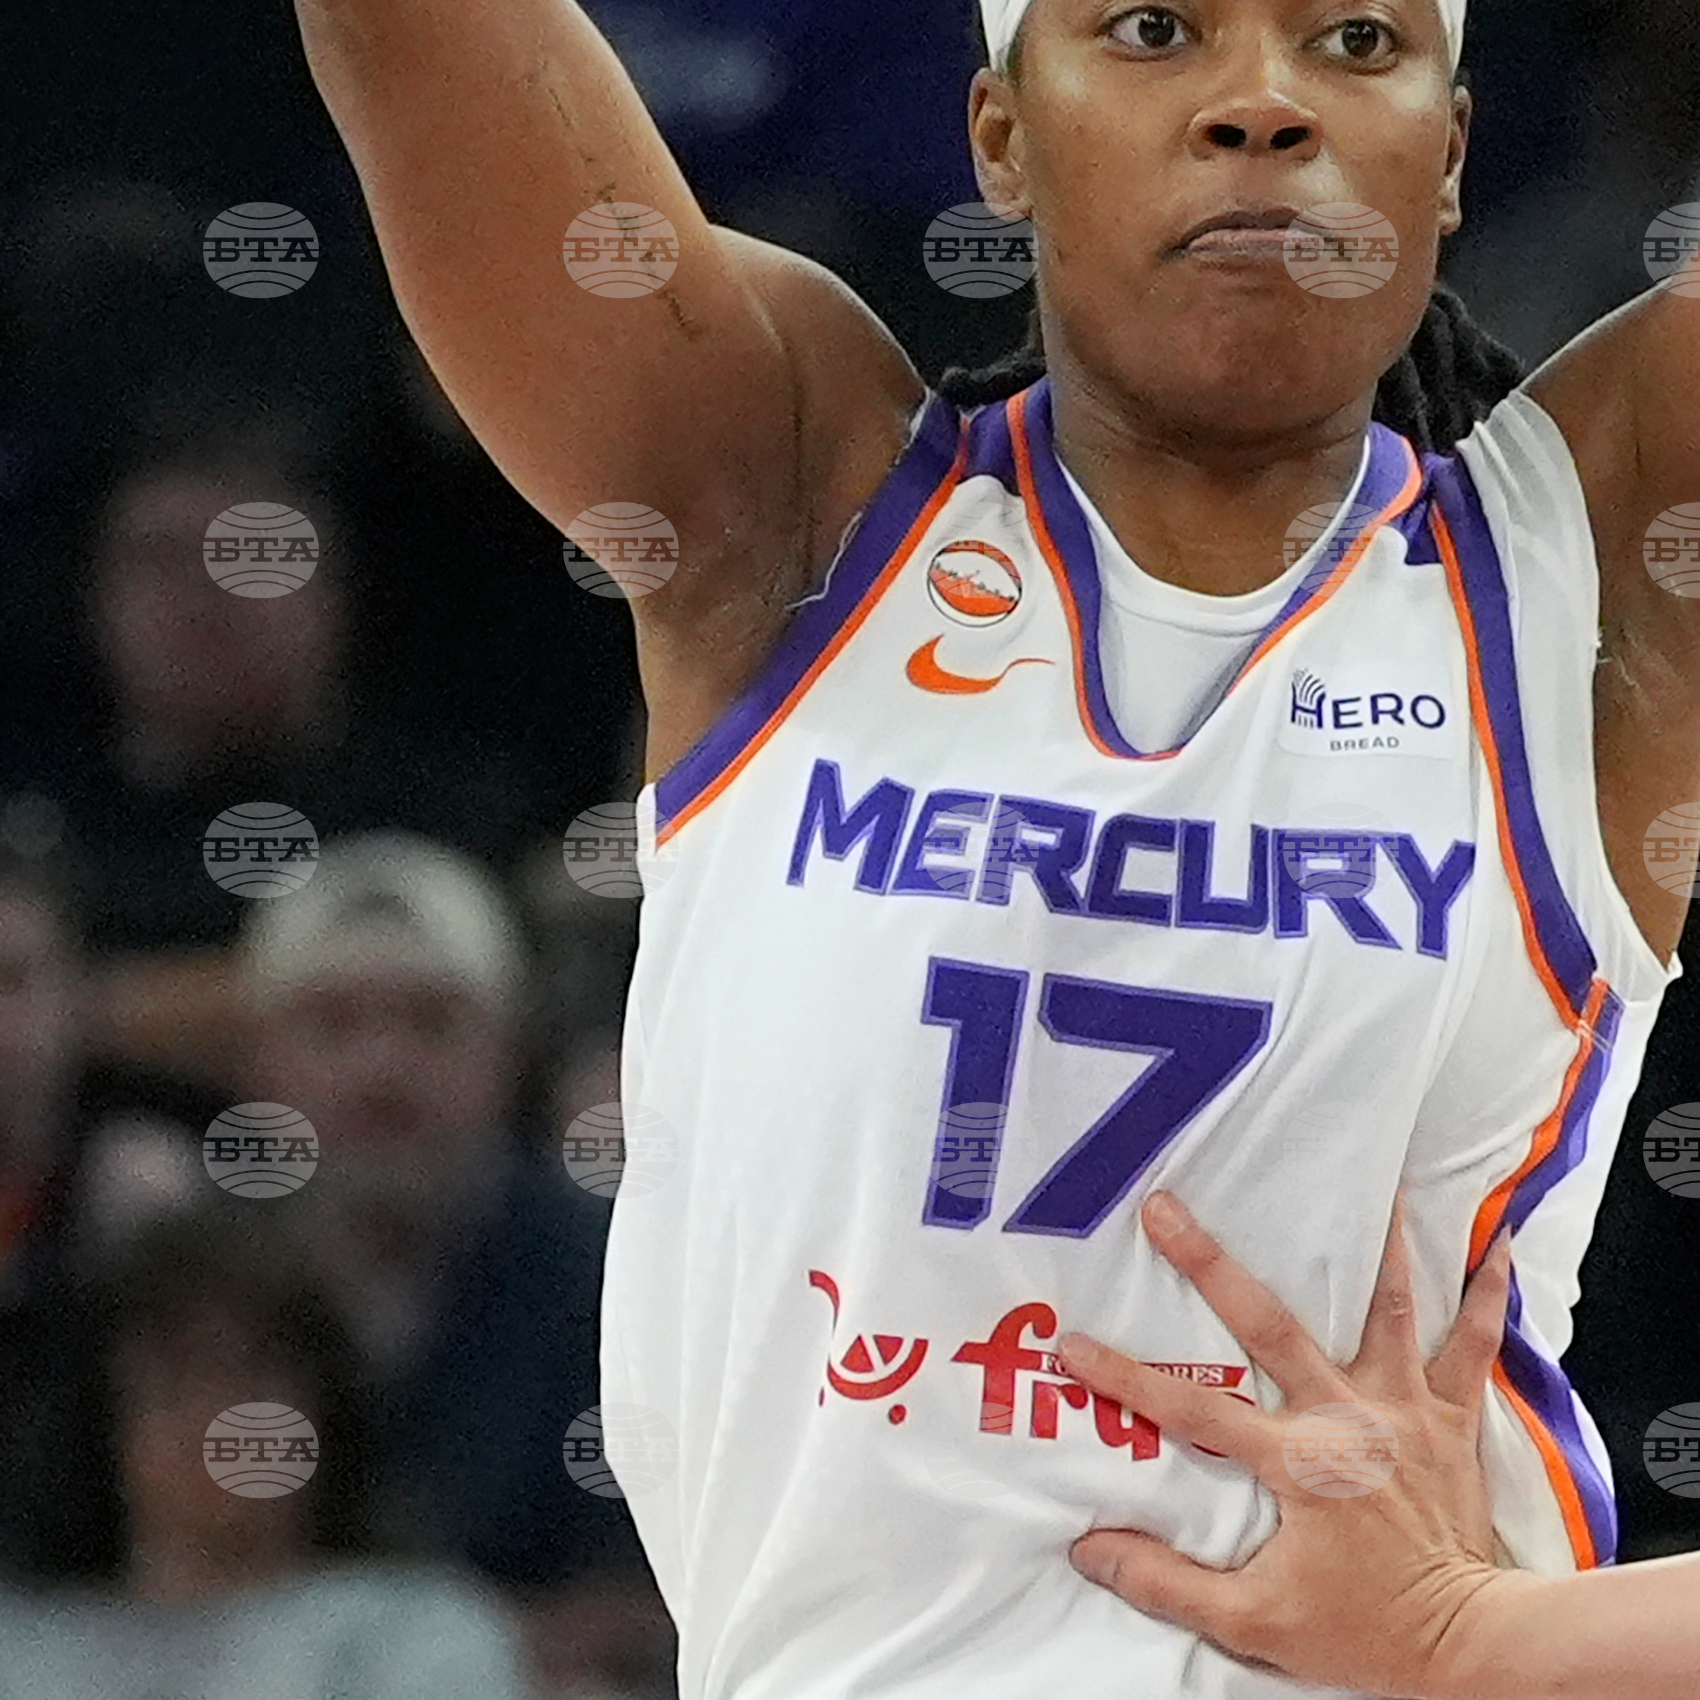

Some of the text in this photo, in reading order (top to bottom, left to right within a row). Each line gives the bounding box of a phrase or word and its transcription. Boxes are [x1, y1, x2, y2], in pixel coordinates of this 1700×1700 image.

[1290, 667, 1447, 730] HERO
[1329, 735, 1401, 752] BREAD
[787, 759, 1475, 961] MERCURY
[921, 955, 1273, 1240] 17
